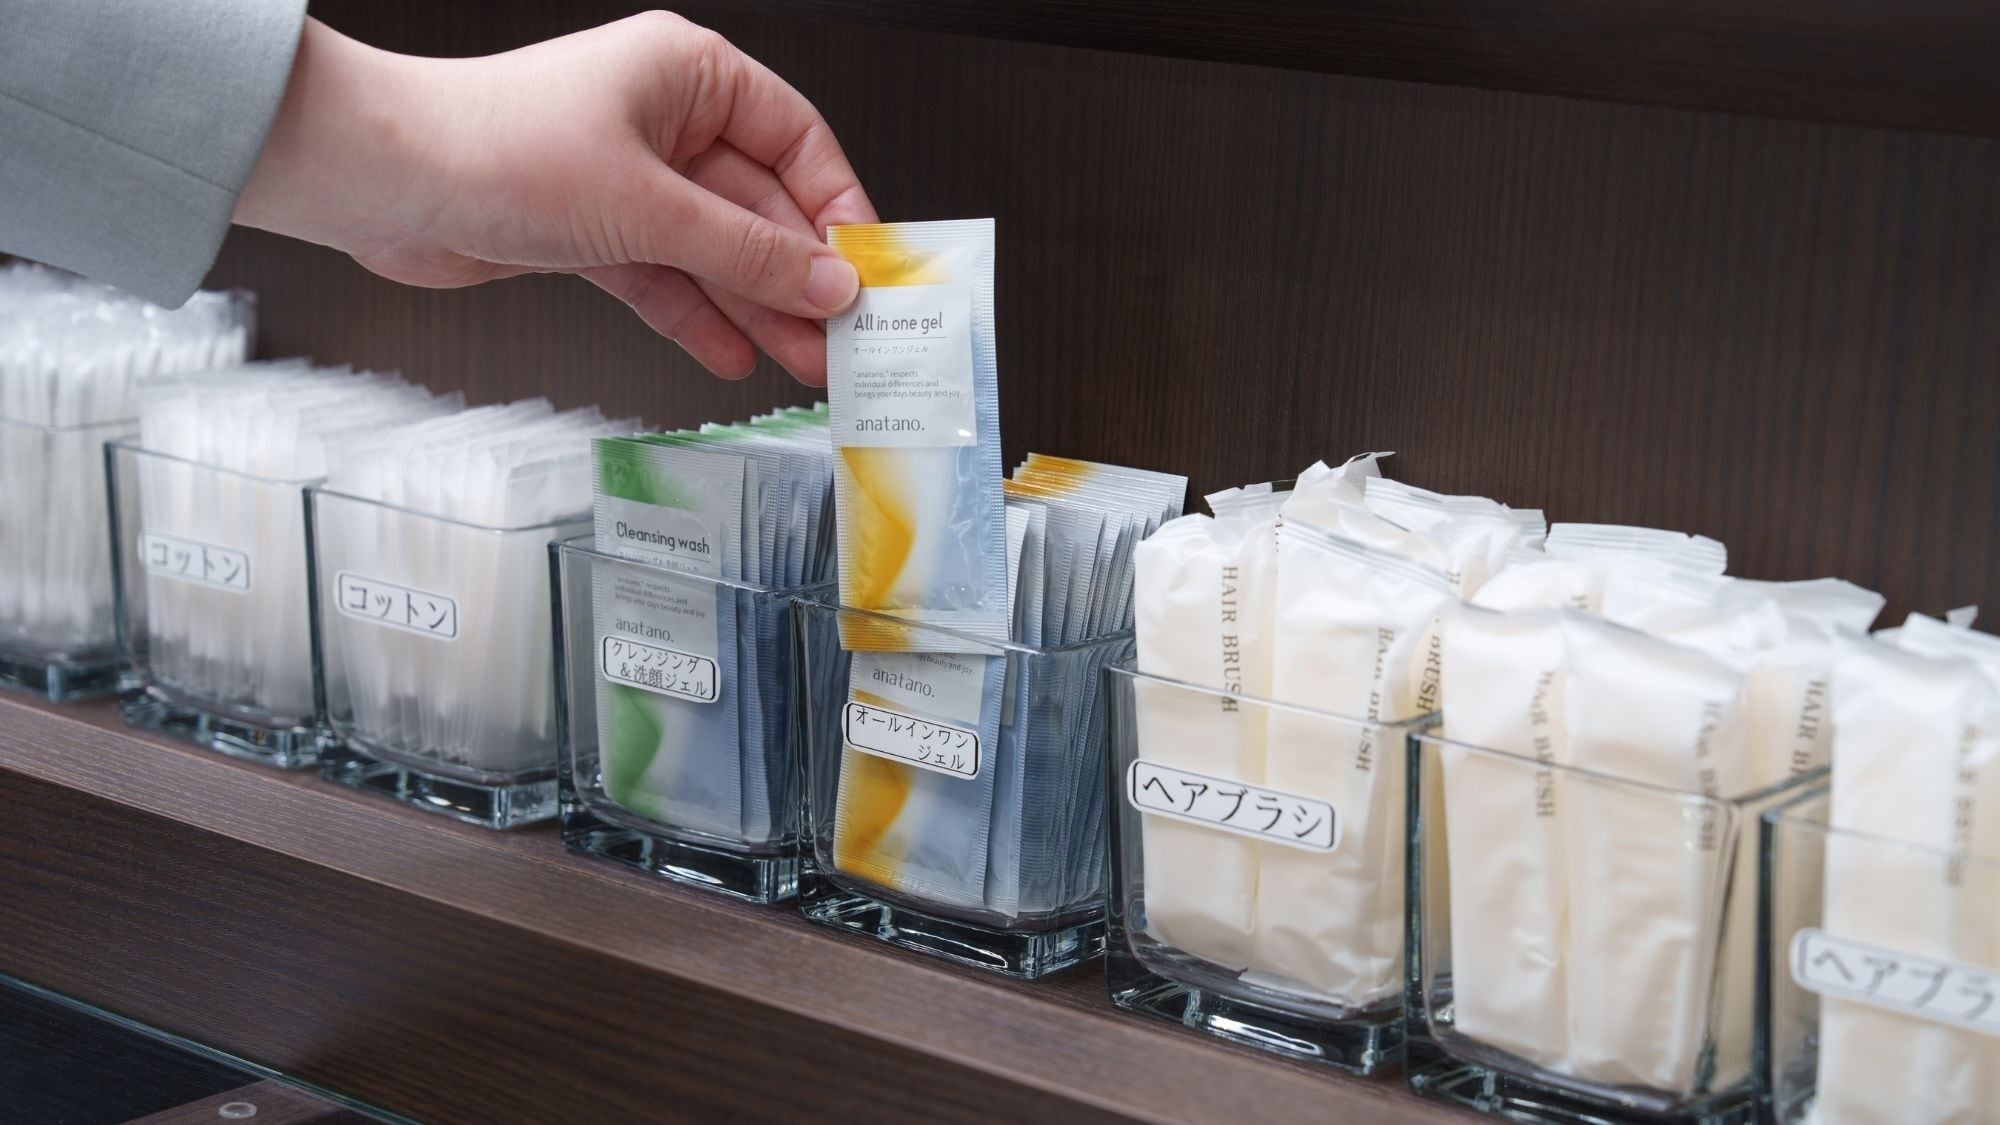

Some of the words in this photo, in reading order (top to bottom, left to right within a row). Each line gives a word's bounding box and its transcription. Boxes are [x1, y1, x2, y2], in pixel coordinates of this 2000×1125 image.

[853, 313, 873, 331] All
[876, 315, 888, 331] in
[892, 318, 917, 331] one
[921, 311, 942, 335] gel
[853, 345, 928, 355] オールインワンジェル
[854, 380, 887, 388] individual
[890, 370, 919, 379] respects
[854, 390, 875, 400] brings
[875, 391, 891, 399] your
[892, 390, 908, 399] days
[909, 390, 932, 399] beauty
[856, 415, 925, 432] anatano.
[616, 521, 675, 551] Cleansing
[677, 537, 710, 554] wash
[151, 542, 241, 585] コットン
[350, 585, 448, 630] コットン
[1221, 566, 1239, 624] HAIR
[616, 617, 674, 643] anatano.
[612, 641, 700, 674] クレンジング
[872, 667, 935, 698] anatano.
[1222, 634, 1242, 713] BRUSH
[855, 707, 969, 749] オールインワン
[917, 744, 966, 770] ジェル
[1142, 776, 1323, 839] ヘアブラシ
